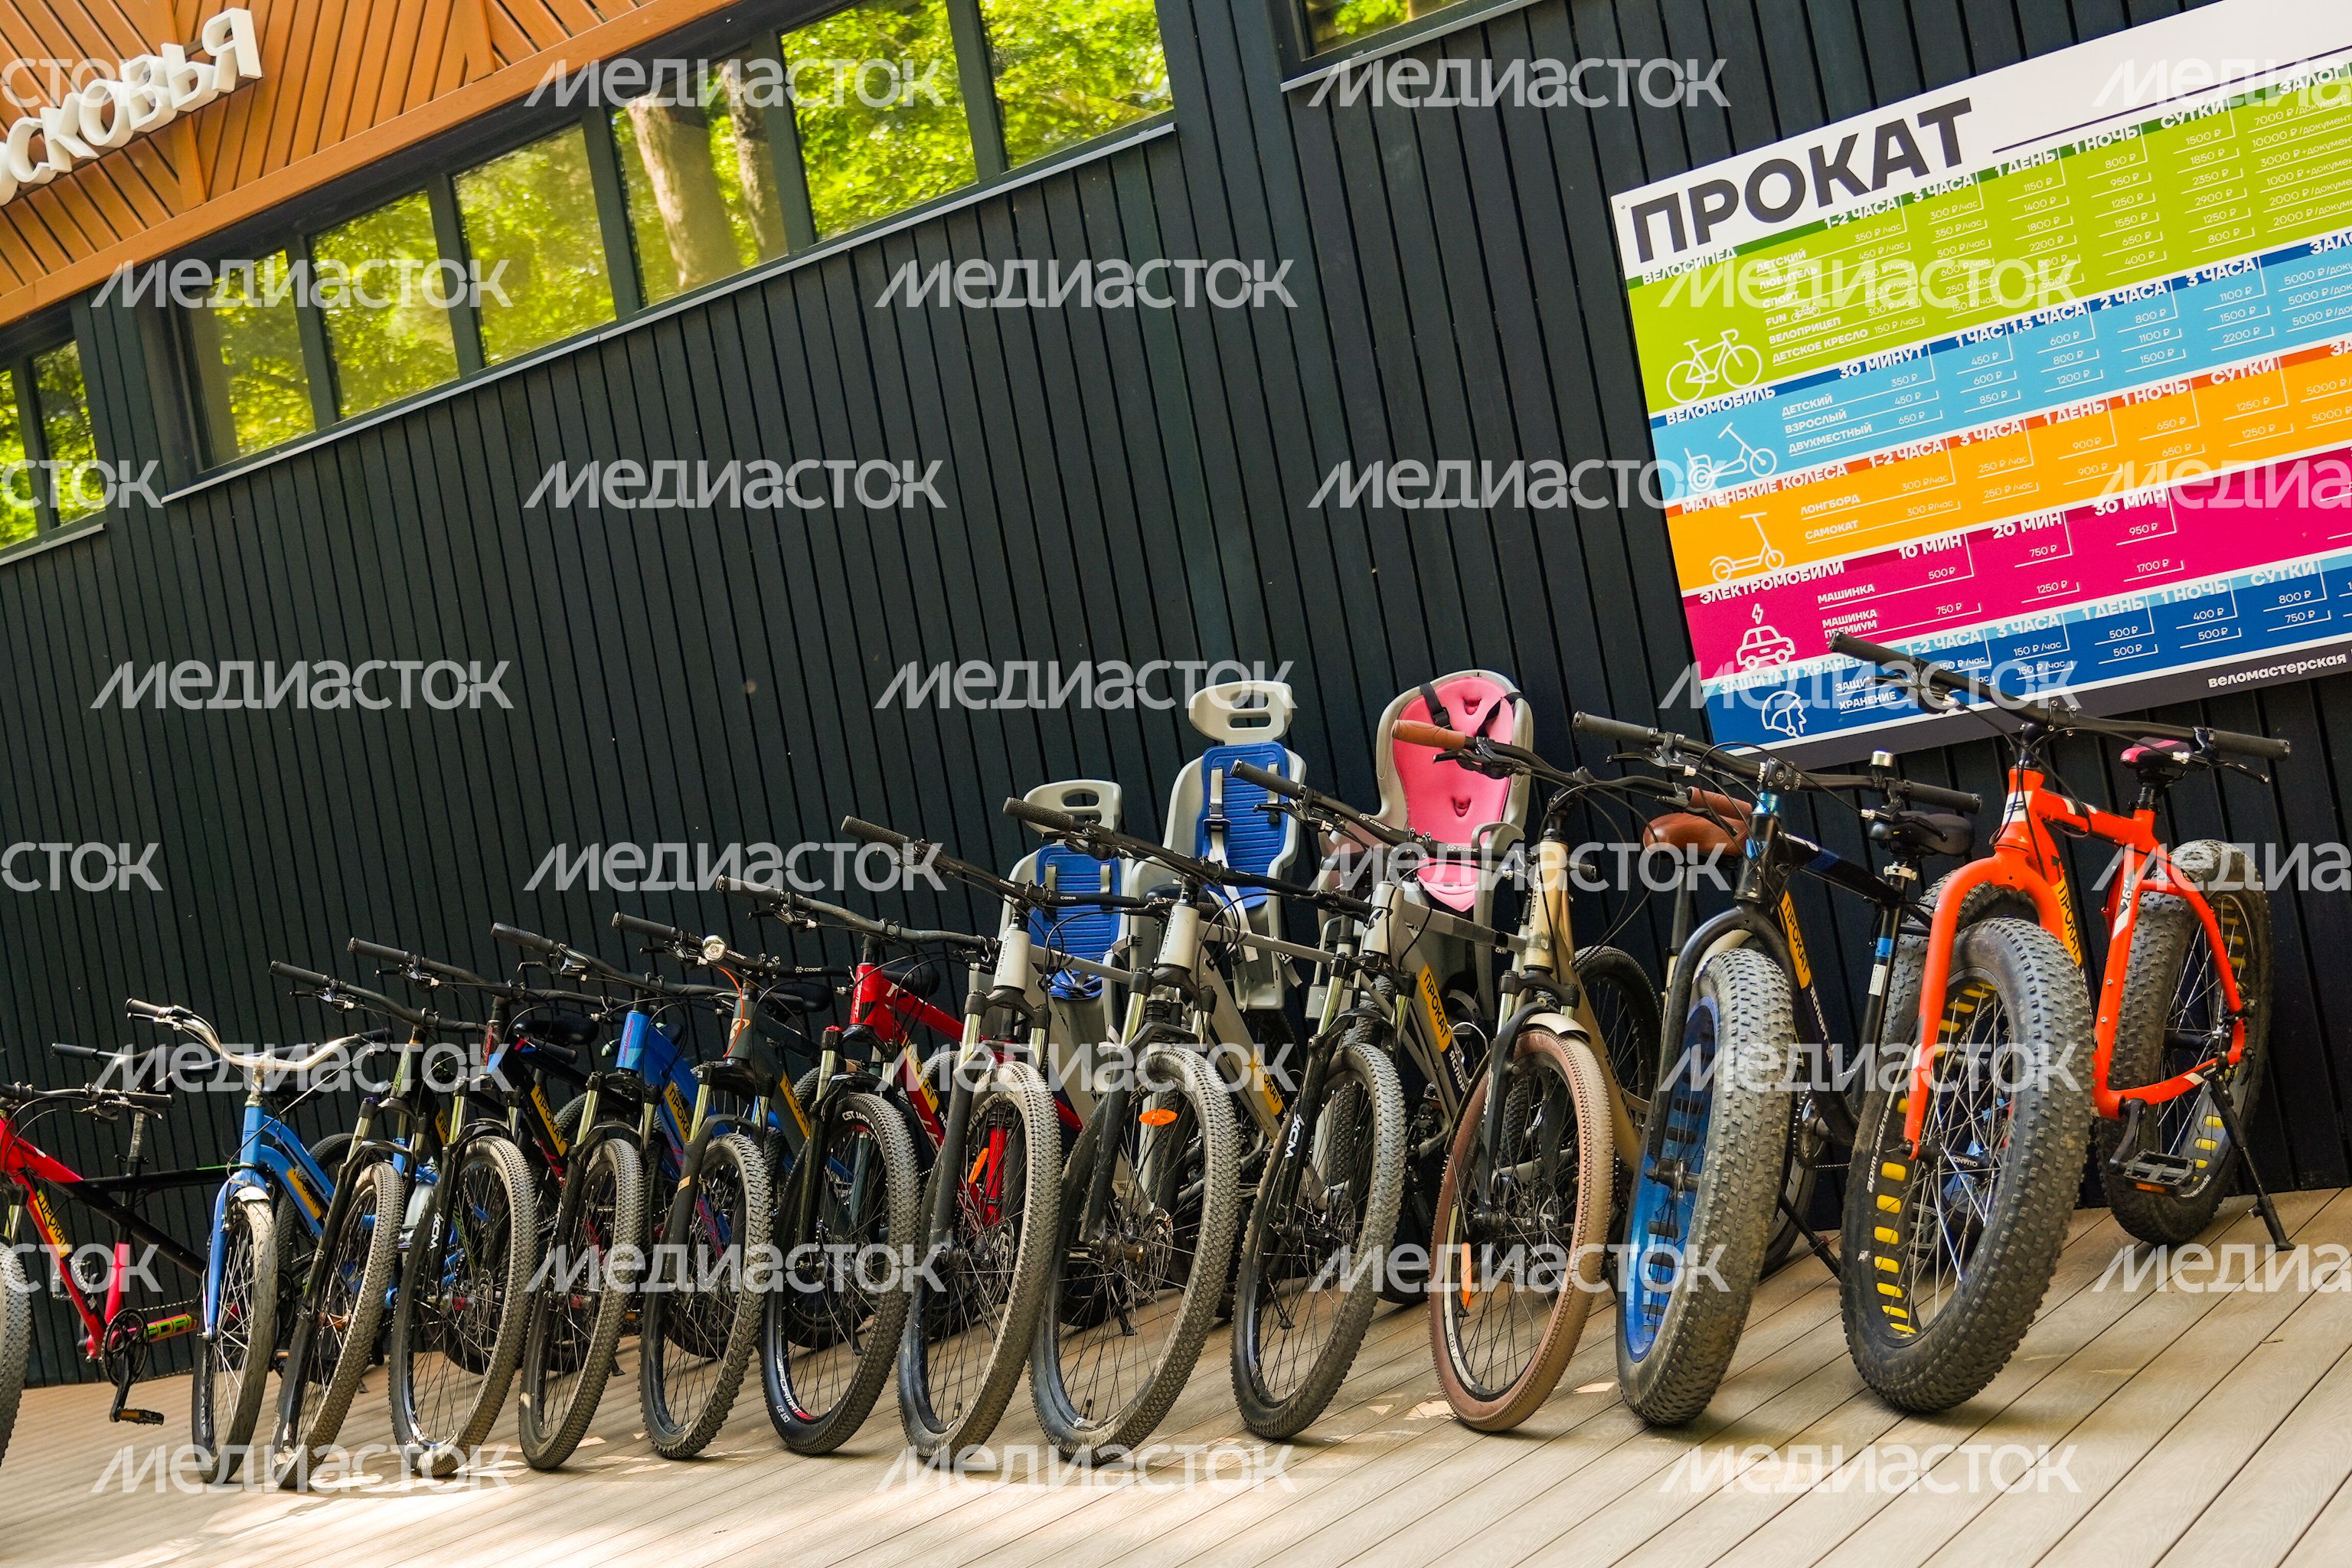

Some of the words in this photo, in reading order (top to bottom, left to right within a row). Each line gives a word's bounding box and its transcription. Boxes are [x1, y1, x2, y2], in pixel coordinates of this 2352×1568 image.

[2278, 66, 2344, 95] ЗАЛОГ
[2161, 98, 2226, 129] СУТКИ
[2085, 126, 2138, 152] НОЧЬ
[2007, 151, 2056, 175] ДЕНЬ
[1631, 97, 1971, 263] ПРОКАТ
[1913, 190, 1923, 202] 3
[1926, 175, 1975, 198] ЧАСА
[1824, 213, 1847, 229] 1-2
[1852, 198, 1899, 218] ЧАСА
[1642, 247, 1738, 285] ВЕЛОСИПЕД
[1756, 250, 1807, 273] ДЕТСКИЙ
[2187, 274, 2200, 287] 3
[2201, 258, 2258, 280] ЧАСА
[1759, 267, 1817, 289] ЛЮБИТЕЛЬ
[1762, 292, 1798, 308] СПОРТ
[2100, 296, 2112, 310] 2
[2114, 281, 2169, 305] ЧАСА
[1766, 314, 1786, 326] FUN
[1769, 317, 1841, 344] ВЕЛОПРИЦЕП
[2011, 319, 2034, 334] 1,5
[2037, 304, 2087, 325] ЧАСА
[1772, 342, 1821, 363] ДЕТСКОЕ
[1824, 329, 1868, 350] КРЕСЛО
[1966, 324, 2004, 342] ЧАС
[1839, 363, 1860, 379] 30
[1864, 345, 1926, 373] МИНУТ
[2210, 358, 2277, 384] СУТКИ
[2135, 381, 2188, 403] НОЧЬ
[1666, 387, 1776, 426] ВЕЛОМОБИЛЬ
[1782, 394, 1833, 417] ДЕТСКИЙ
[2056, 401, 2105, 423] ДЕНЬ
[1785, 410, 1847, 434] ВЗРОСЛЫЙ
[1960, 432, 1971, 446] 3
[1974, 420, 2024, 443] ЧАСА
[1788, 423, 1872, 454] ДВУХМЕСТНЫЙ
[1867, 451, 1895, 469] 1-2
[1897, 439, 1945, 460] ЧАСА
[1682, 480, 1779, 514] МАЛЕНЬКИЕ
[1781, 463, 1849, 492] КОЛЕСА
[1801, 494, 1860, 514] ЛОНГБОРД
[2095, 500, 2118, 517] 30
[2124, 488, 2167, 510] МИН
[1805, 520, 1858, 540] САМОКАТ
[1992, 523, 2016, 539] 20
[2020, 511, 2062, 533] МИН
[1899, 545, 1917, 560] 10
[1922, 535, 1962, 556] МИН
[1699, 561, 1844, 605] ЭЛЕКТРОМОБИЛИ
[2251, 562, 2316, 586] СУТКИ
[1818, 584, 1875, 603] МАШИНКА
[2174, 580, 2229, 602] НОЧЬ
[1822, 609, 1877, 629] МАШИНКА
[2095, 598, 2144, 618] ДЕНЬ
[1997, 626, 2007, 638] 3
[2011, 614, 2061, 633] ЧАСА
[1933, 630, 1981, 651] ЧАСА
[1719, 672, 1784, 694] ЗАЩИТА
[2208, 654, 2347, 688] веломастерская
[1839, 691, 1896, 710] ХРАНЕНИЕ
[1785, 900, 1809, 972] ПРОКАТ
[1425, 973, 1449, 1038] ПРОКАТ
[536, 1090, 564, 1145] ПРОКАТ
[668, 1089, 690, 1140] ПРОКА
